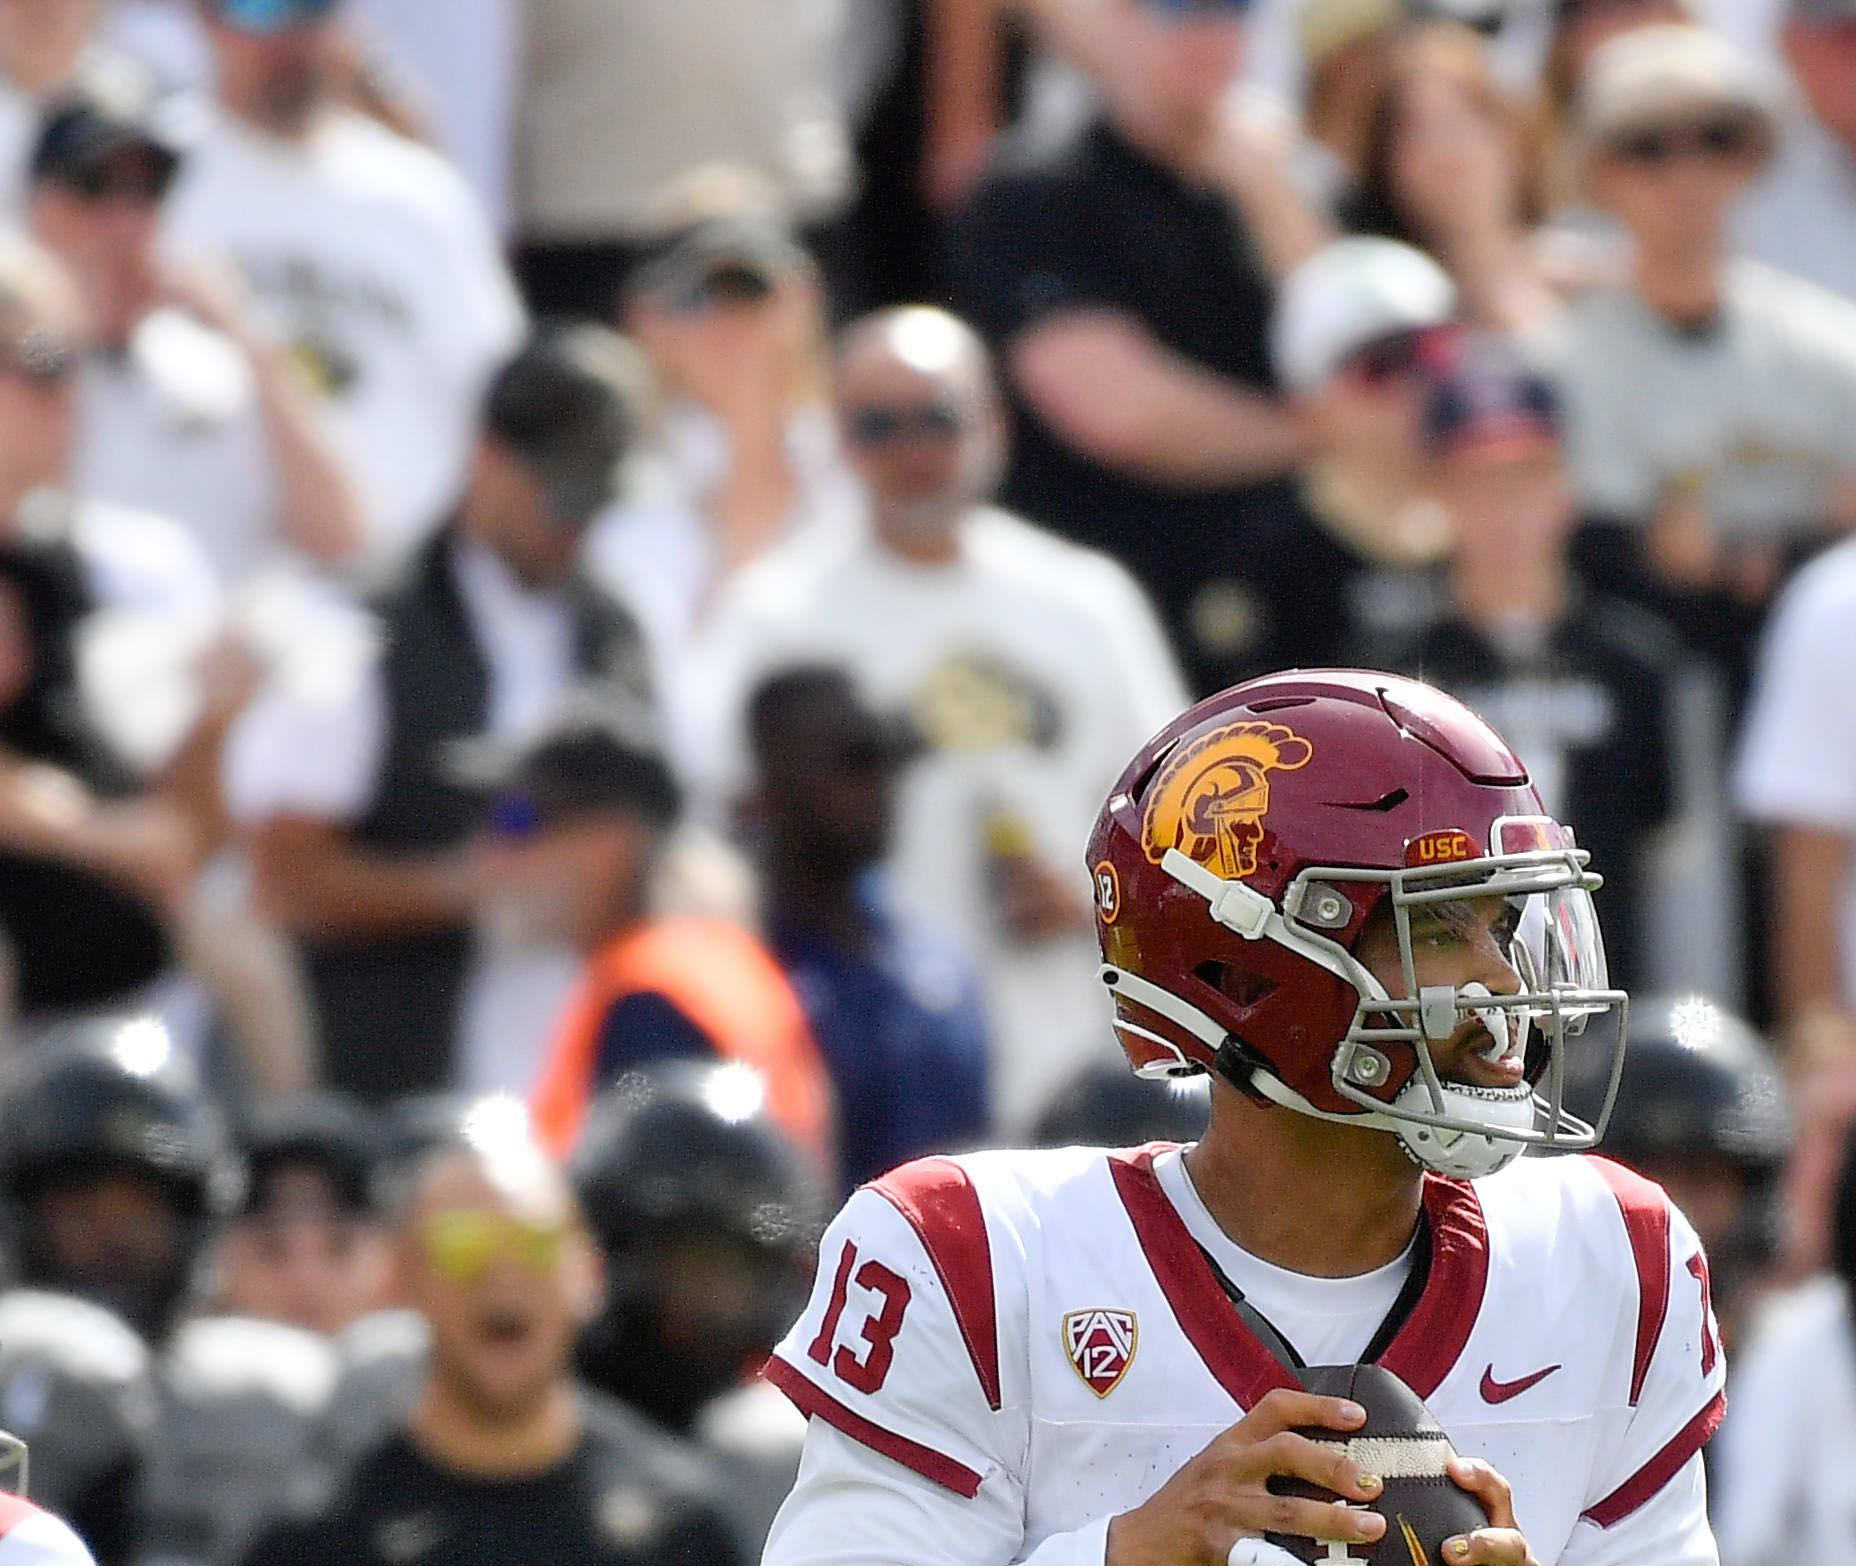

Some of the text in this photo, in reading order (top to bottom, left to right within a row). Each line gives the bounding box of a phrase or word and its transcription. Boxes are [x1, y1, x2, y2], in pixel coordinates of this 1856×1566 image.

[1418, 835, 1468, 860] USC
[1097, 873, 1115, 910] 12
[807, 1238, 912, 1396] 13
[1067, 1311, 1133, 1362] PAC
[1083, 1345, 1120, 1379] 12
